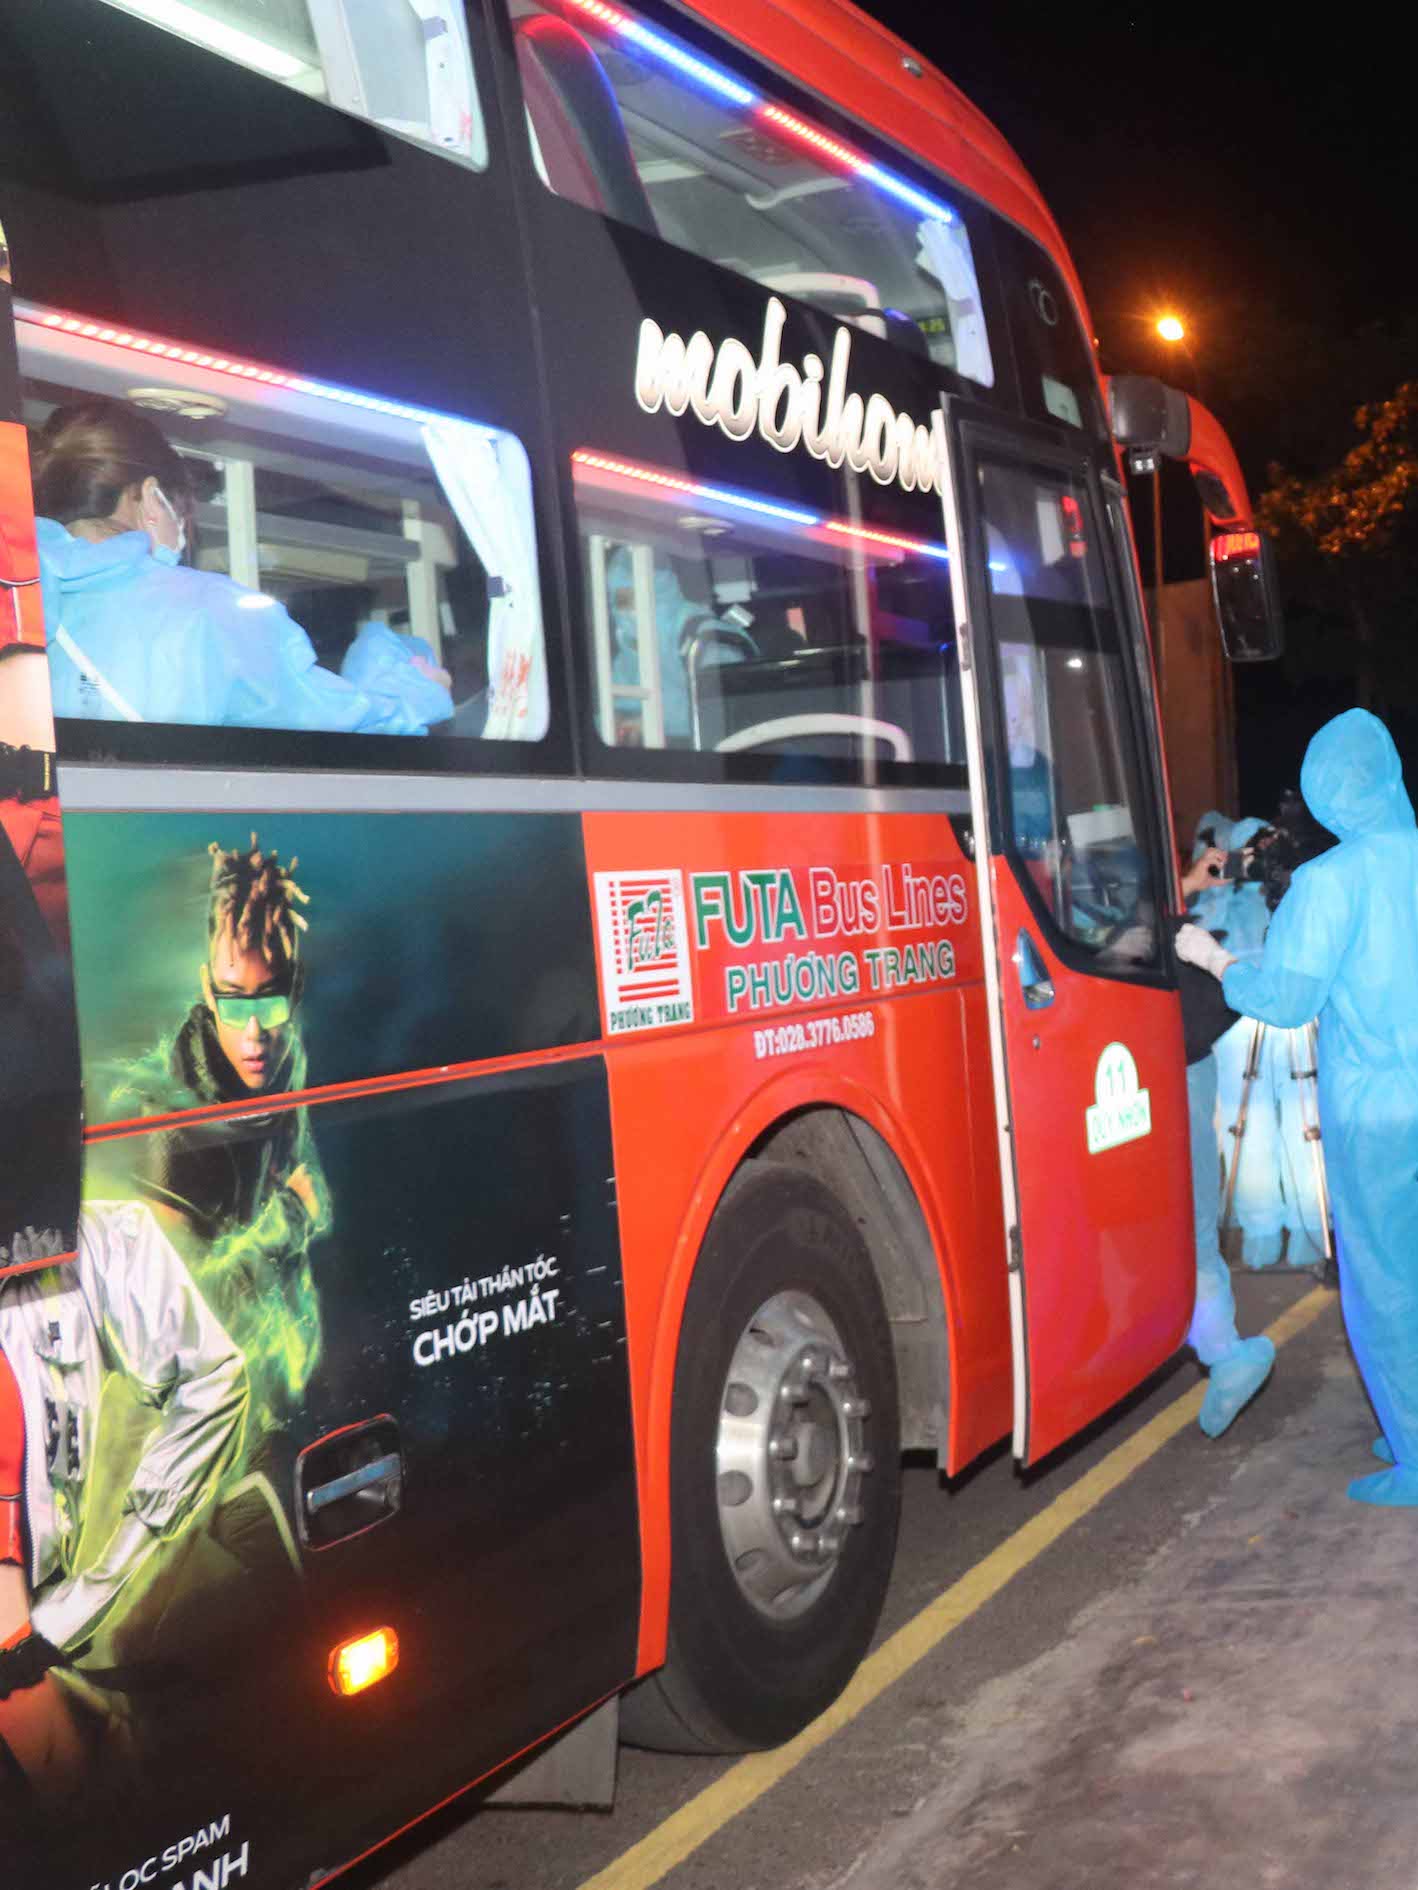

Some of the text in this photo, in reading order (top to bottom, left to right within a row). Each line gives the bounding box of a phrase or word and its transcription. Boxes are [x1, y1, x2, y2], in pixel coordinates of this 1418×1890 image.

[690, 863, 968, 950] FUTA Bus Lines
[726, 938, 956, 1013] PHƯƠNG TRANG
[657, 1001, 691, 1023] TRANG
[409, 1289, 450, 1321] SIÊU
[450, 1277, 478, 1308] TẢI
[524, 1253, 560, 1283] TỐC
[413, 1282, 560, 1367] CHỚP MẮT
[161, 1813, 231, 1871] SPAM
